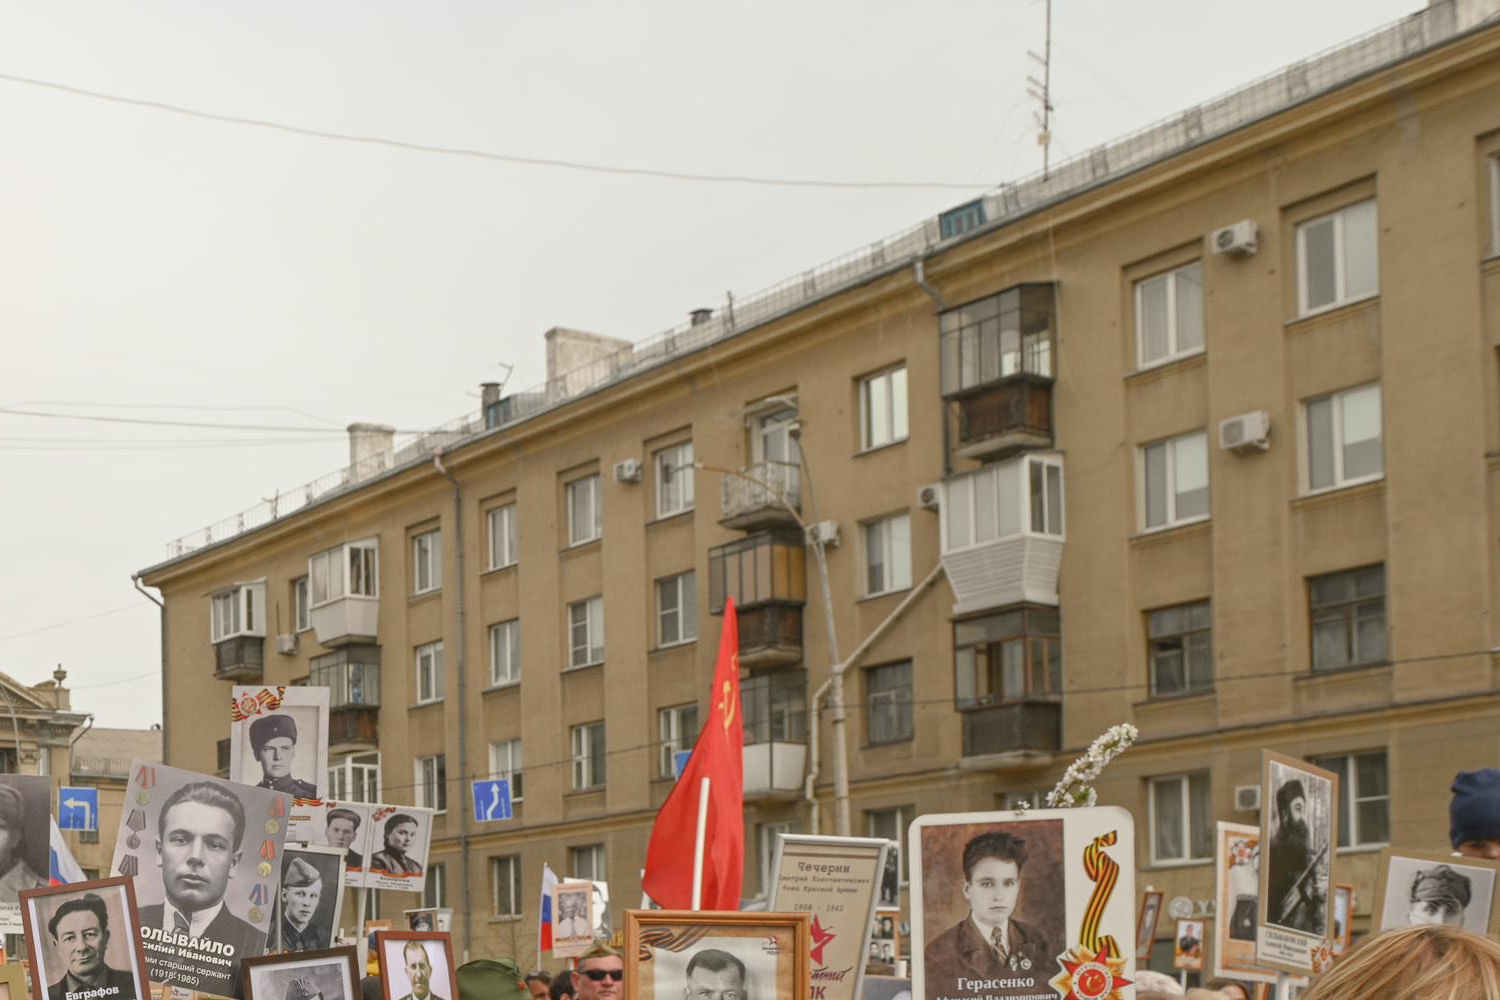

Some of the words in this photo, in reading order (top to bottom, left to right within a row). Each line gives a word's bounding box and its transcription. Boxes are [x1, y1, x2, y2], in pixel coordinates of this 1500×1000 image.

[798, 862, 850, 875] Чечерин
[140, 925, 235, 957] ОЛЫВАЙЛО
[142, 941, 176, 955] силий
[177, 948, 232, 968] Иванович
[158, 958, 195, 973] старший
[196, 967, 231, 981] сержант
[956, 977, 1035, 993] Герасенко
